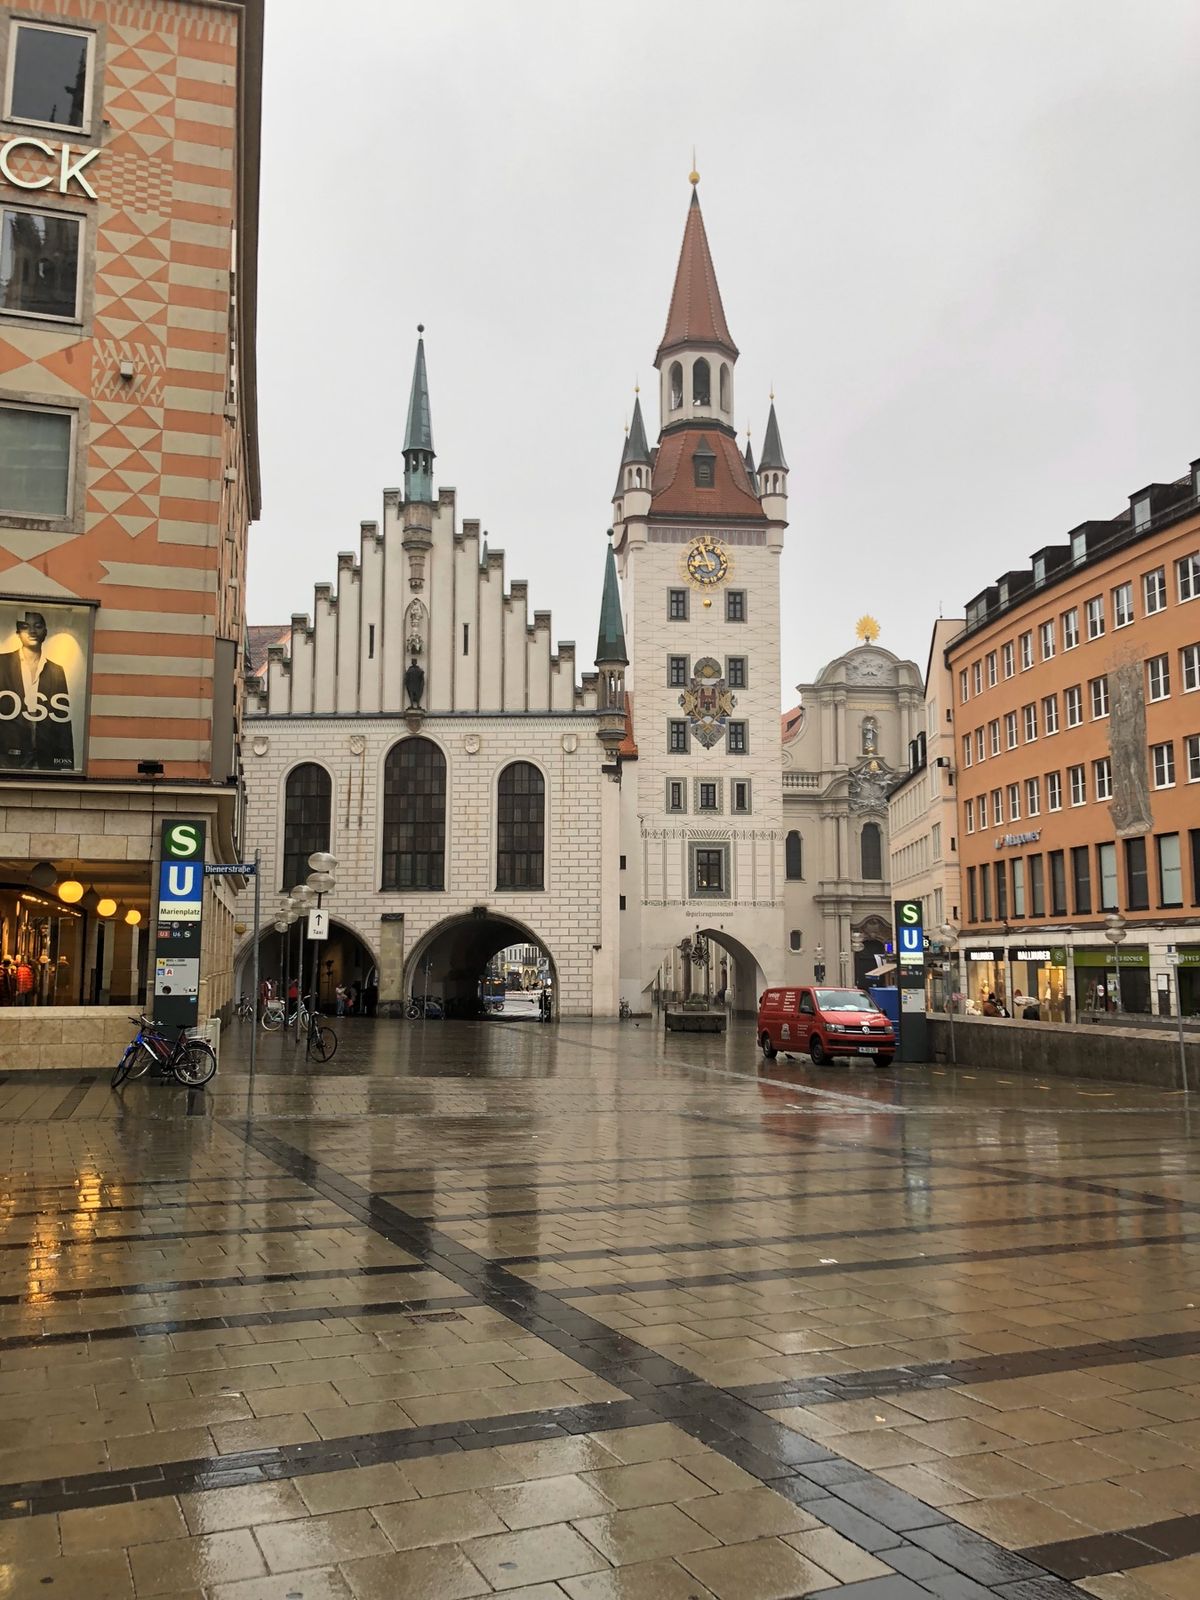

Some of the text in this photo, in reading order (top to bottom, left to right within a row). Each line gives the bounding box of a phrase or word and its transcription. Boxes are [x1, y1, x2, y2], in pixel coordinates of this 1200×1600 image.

[0, 136, 101, 199] CK
[171, 825, 197, 856] S
[205, 864, 251, 874] Dienerstraße
[169, 866, 194, 896] U
[160, 908, 200, 916] Marienplatz
[903, 904, 918, 924] S
[903, 929, 918, 949] U
